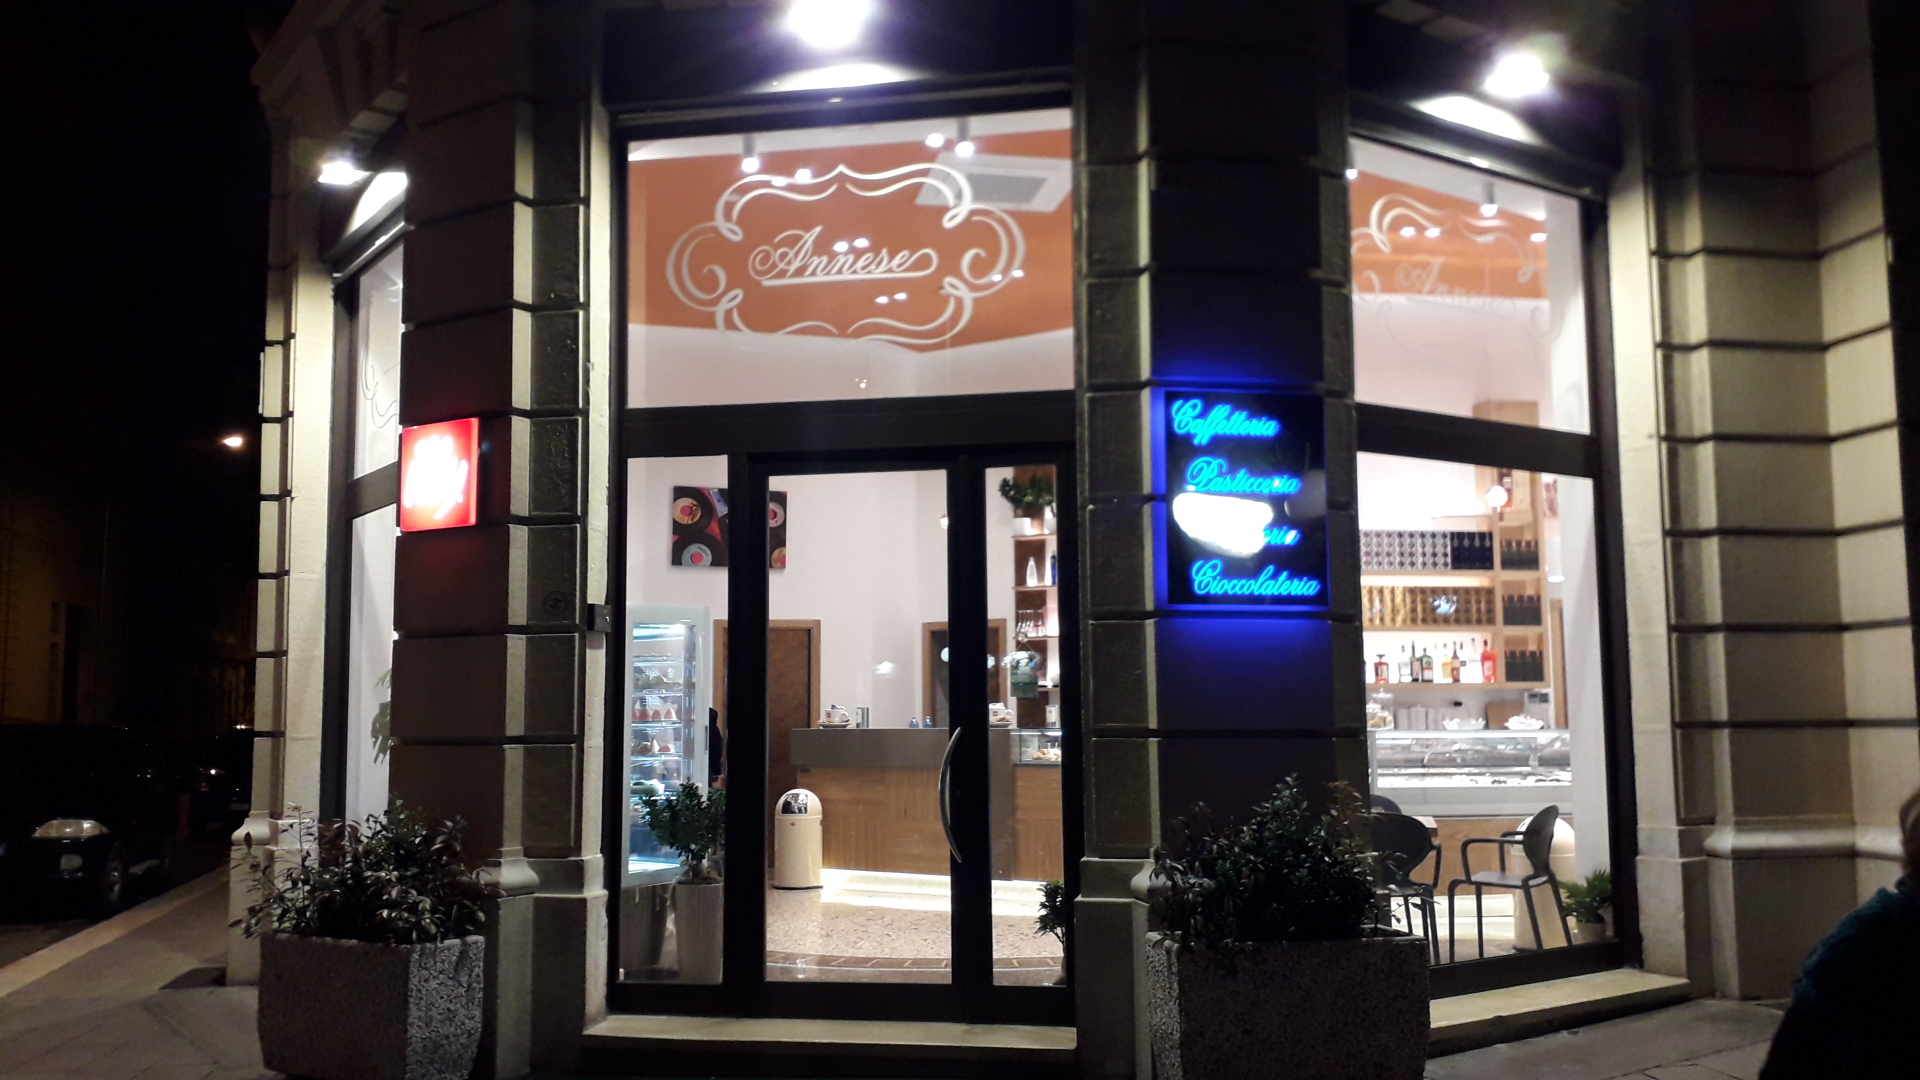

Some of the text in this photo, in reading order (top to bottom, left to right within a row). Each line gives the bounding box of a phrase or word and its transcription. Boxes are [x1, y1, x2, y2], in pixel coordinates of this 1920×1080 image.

[748, 224, 938, 286] Annese
[1172, 399, 1280, 445] Caffetteria
[1186, 457, 1301, 494] Pasticceria
[1191, 559, 1321, 596] Cioccolateria
